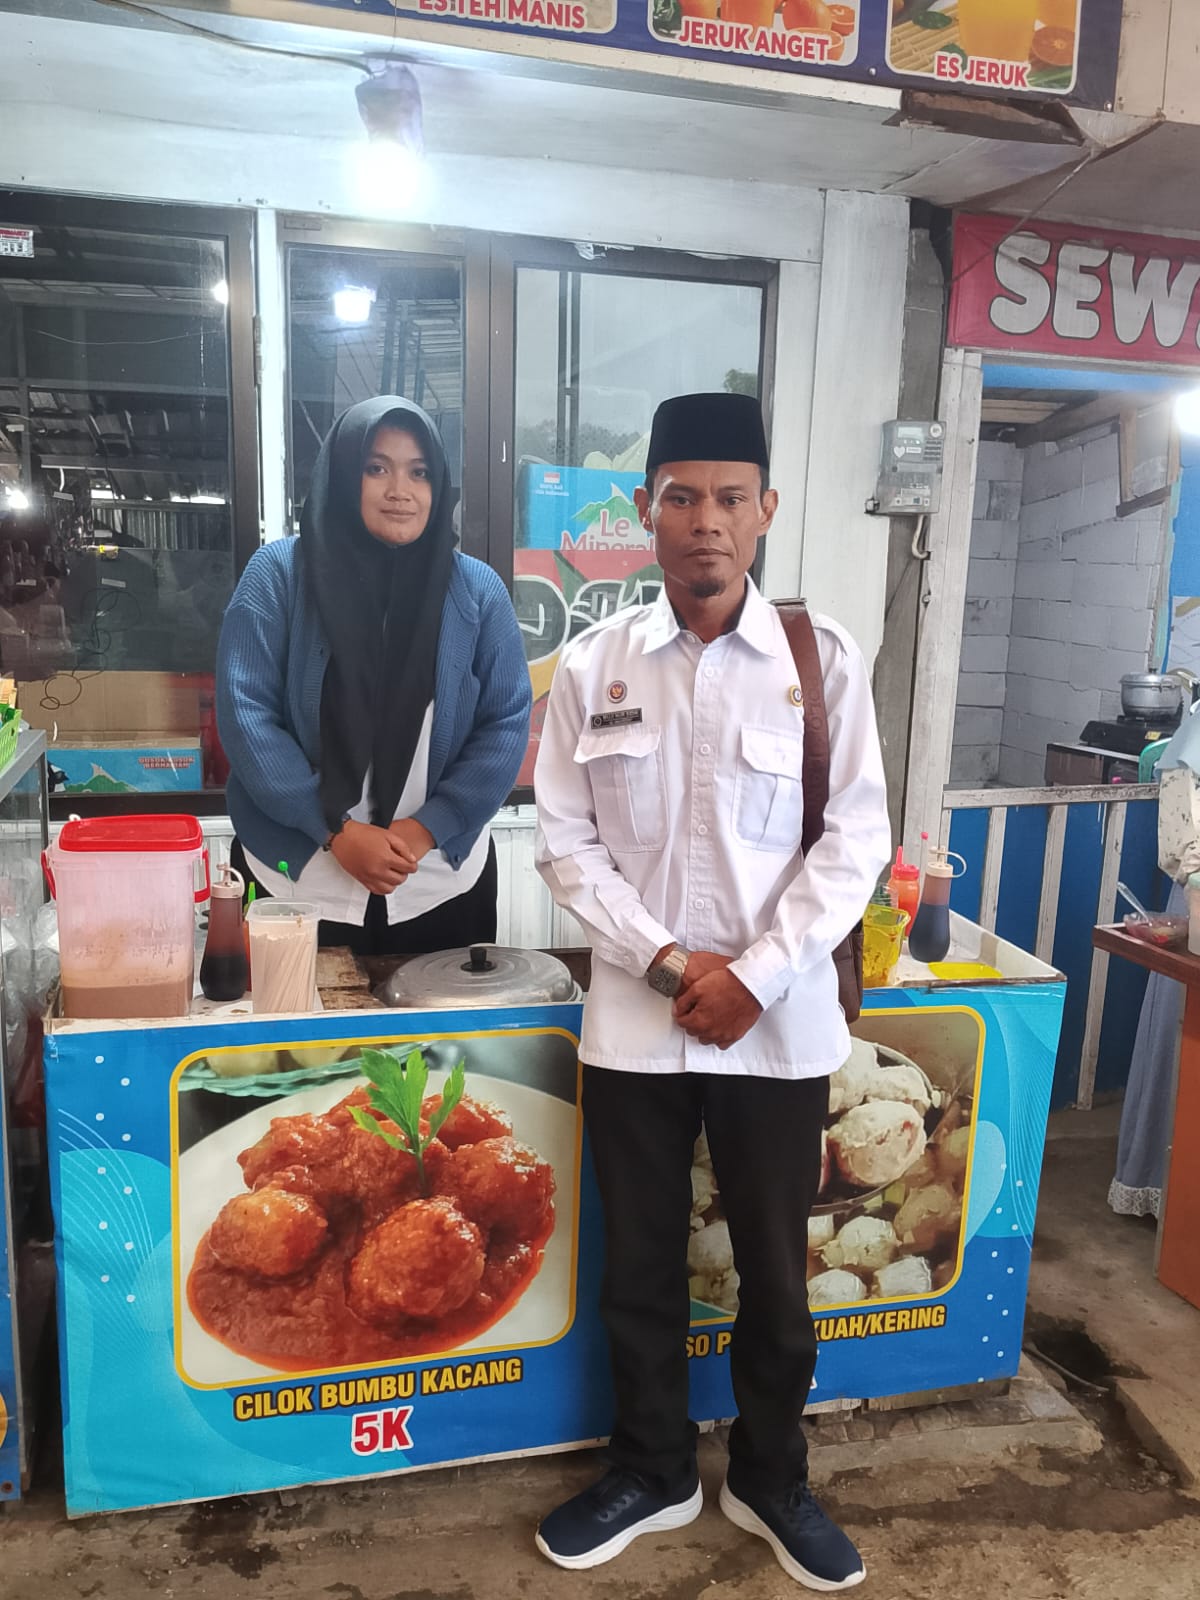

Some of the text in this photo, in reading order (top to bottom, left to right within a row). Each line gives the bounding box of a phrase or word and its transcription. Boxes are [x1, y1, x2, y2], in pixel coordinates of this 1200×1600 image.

[508, 0, 586, 29] MANIS
[679, 20, 830, 61] JERUK ANGET
[936, 55, 1029, 88] ES JERUK
[989, 231, 1200, 349] SEW
[600, 510, 632, 538] Le
[234, 1357, 523, 1421] CILOK BUMBU KACANG
[353, 1406, 412, 1455] 5K
